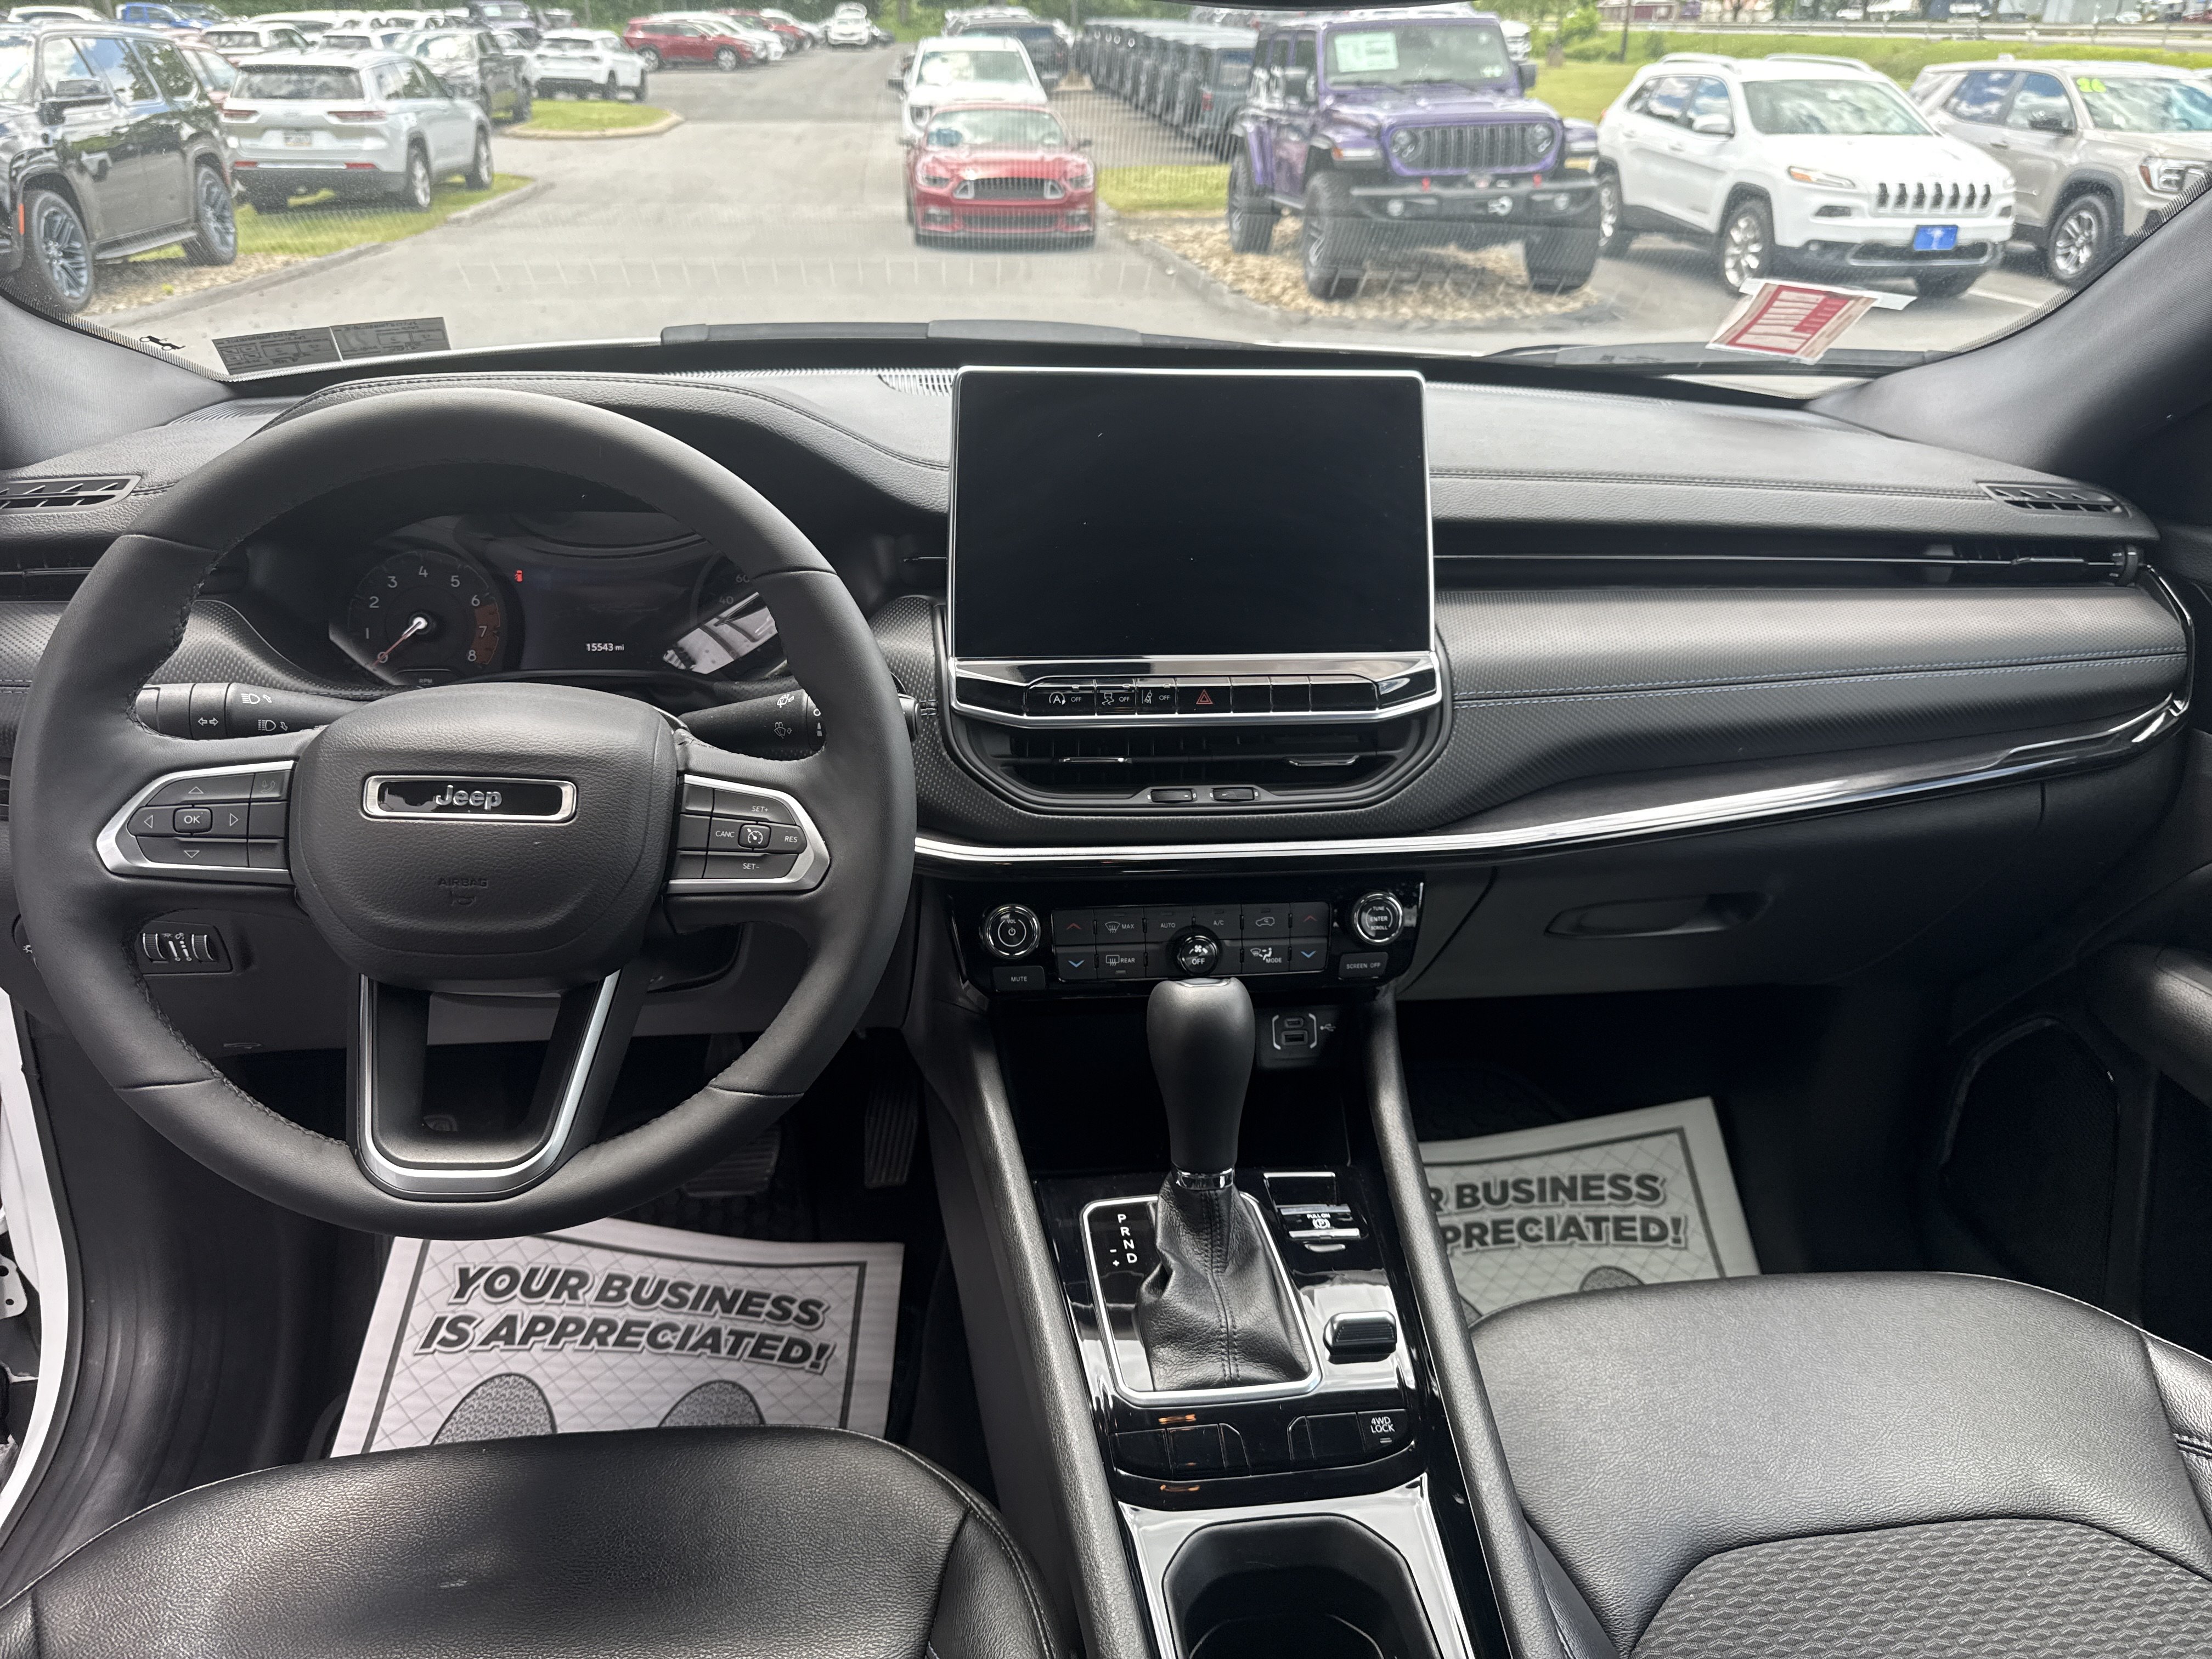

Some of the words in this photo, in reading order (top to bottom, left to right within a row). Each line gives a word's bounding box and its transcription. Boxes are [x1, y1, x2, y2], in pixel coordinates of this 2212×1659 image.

[419, 566, 428, 578] 4
[388, 577, 398, 588] 3
[451, 575, 460, 587] 5
[369, 596, 380, 608] 2
[471, 595, 481, 606] 6
[719, 596, 733, 605] 40
[479, 626, 488, 637] 7
[586, 642, 614, 652] 15543
[468, 650, 477, 662] 8
[436, 785, 503, 811] Jeep
[184, 815, 201, 824] OK
[439, 878, 489, 888] AIRBAG
[1454, 1173, 1663, 1209] BUSINESS
[1117, 1214, 1126, 1223] P
[1120, 1226, 1130, 1237] R
[1440, 1214, 1684, 1249] PRECIATED!
[1123, 1239, 1135, 1249] N
[1126, 1252, 1137, 1263] D
[451, 1264, 595, 1305] YOUR
[591, 1271, 830, 1328] BUSINESS
[416, 1313, 482, 1352] IS
[475, 1312, 834, 1372] APPRECIATED!
[1371, 1416, 1391, 1425] 4WD
[1370, 1424, 1396, 1434] LOCK
